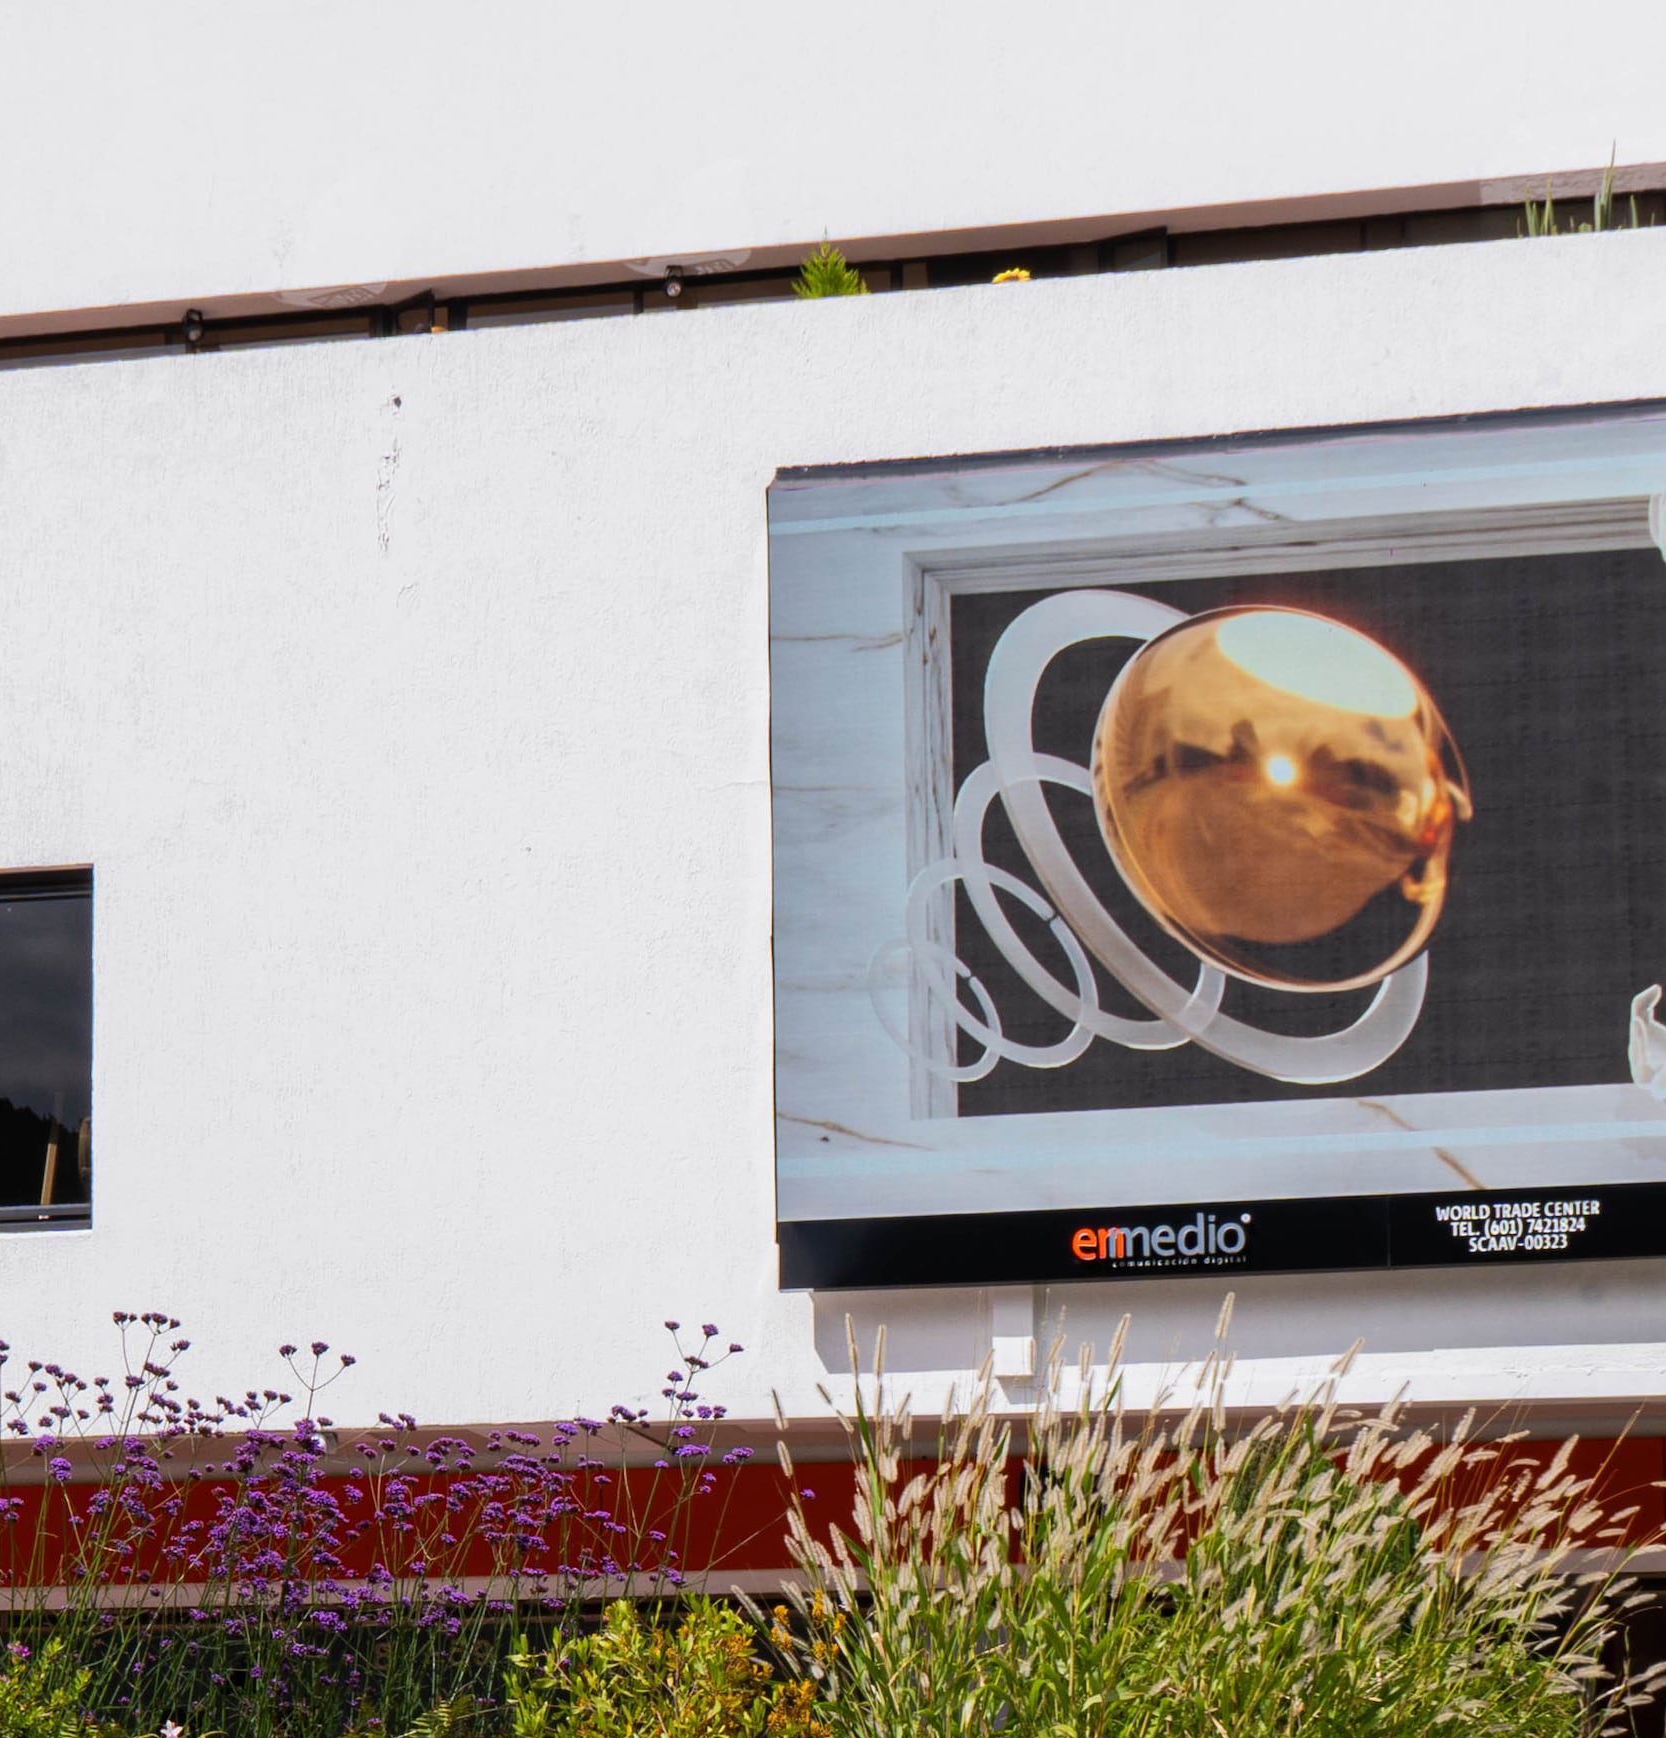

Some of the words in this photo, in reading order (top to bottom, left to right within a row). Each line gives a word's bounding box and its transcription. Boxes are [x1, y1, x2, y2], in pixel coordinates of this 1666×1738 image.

[1435, 1204, 1490, 1221] WORLD
[1493, 1202, 1541, 1219] TRADE
[1543, 1200, 1601, 1217] CENTER
[1450, 1221, 1480, 1237] TEL.
[1484, 1218, 1523, 1238] (601)
[1526, 1217, 1586, 1233] 7421824
[1468, 1233, 1568, 1253] SCAAV-00323
